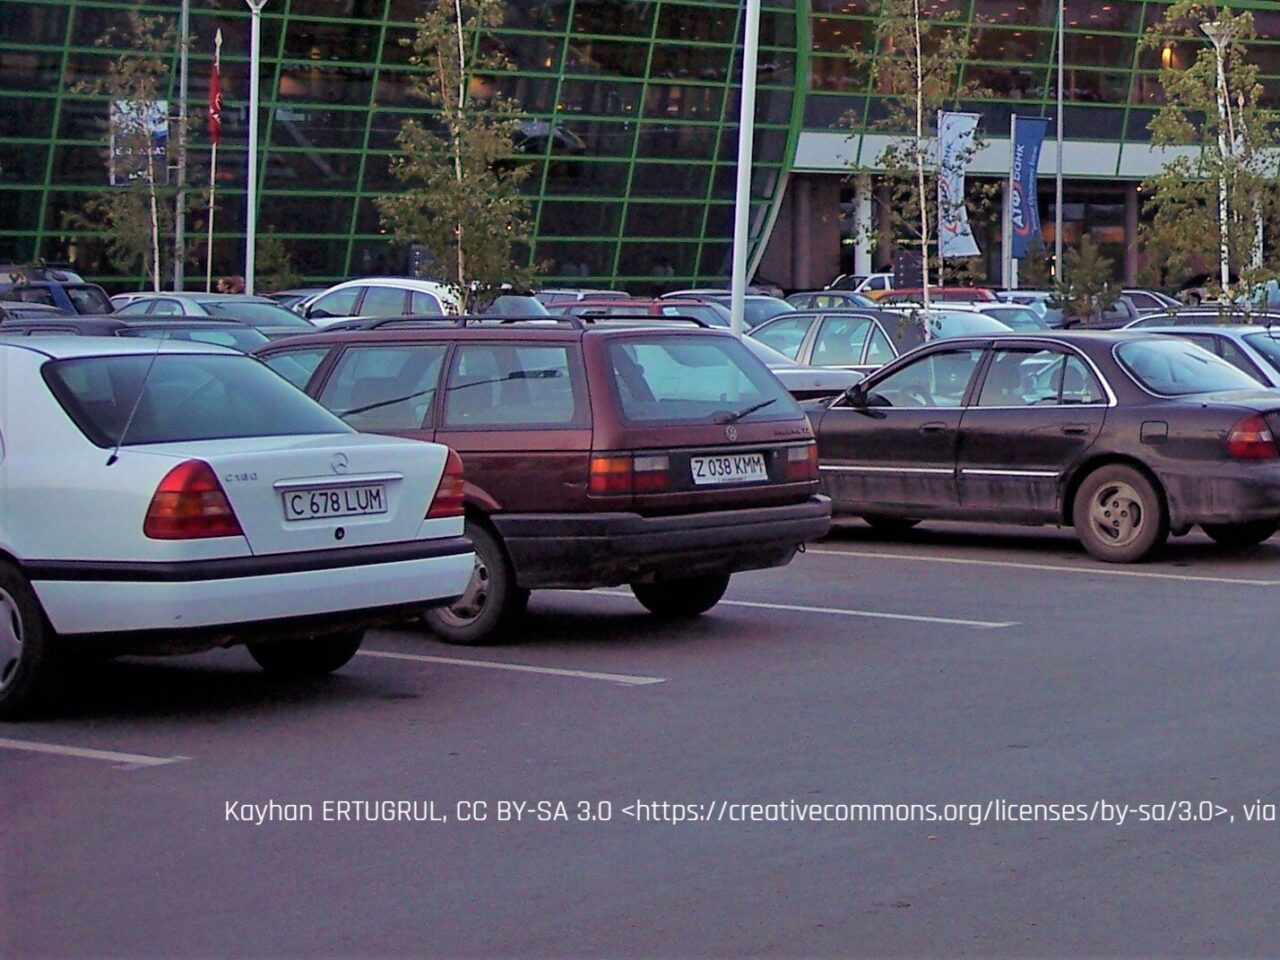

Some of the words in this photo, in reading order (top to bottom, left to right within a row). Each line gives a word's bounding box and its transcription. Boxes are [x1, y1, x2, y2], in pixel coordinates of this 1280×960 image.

[694, 460, 706, 477] Z
[708, 458, 732, 476] 038
[733, 455, 763, 475] KMM
[291, 494, 304, 515] C
[310, 492, 341, 514] 678
[344, 488, 382, 511] LUM
